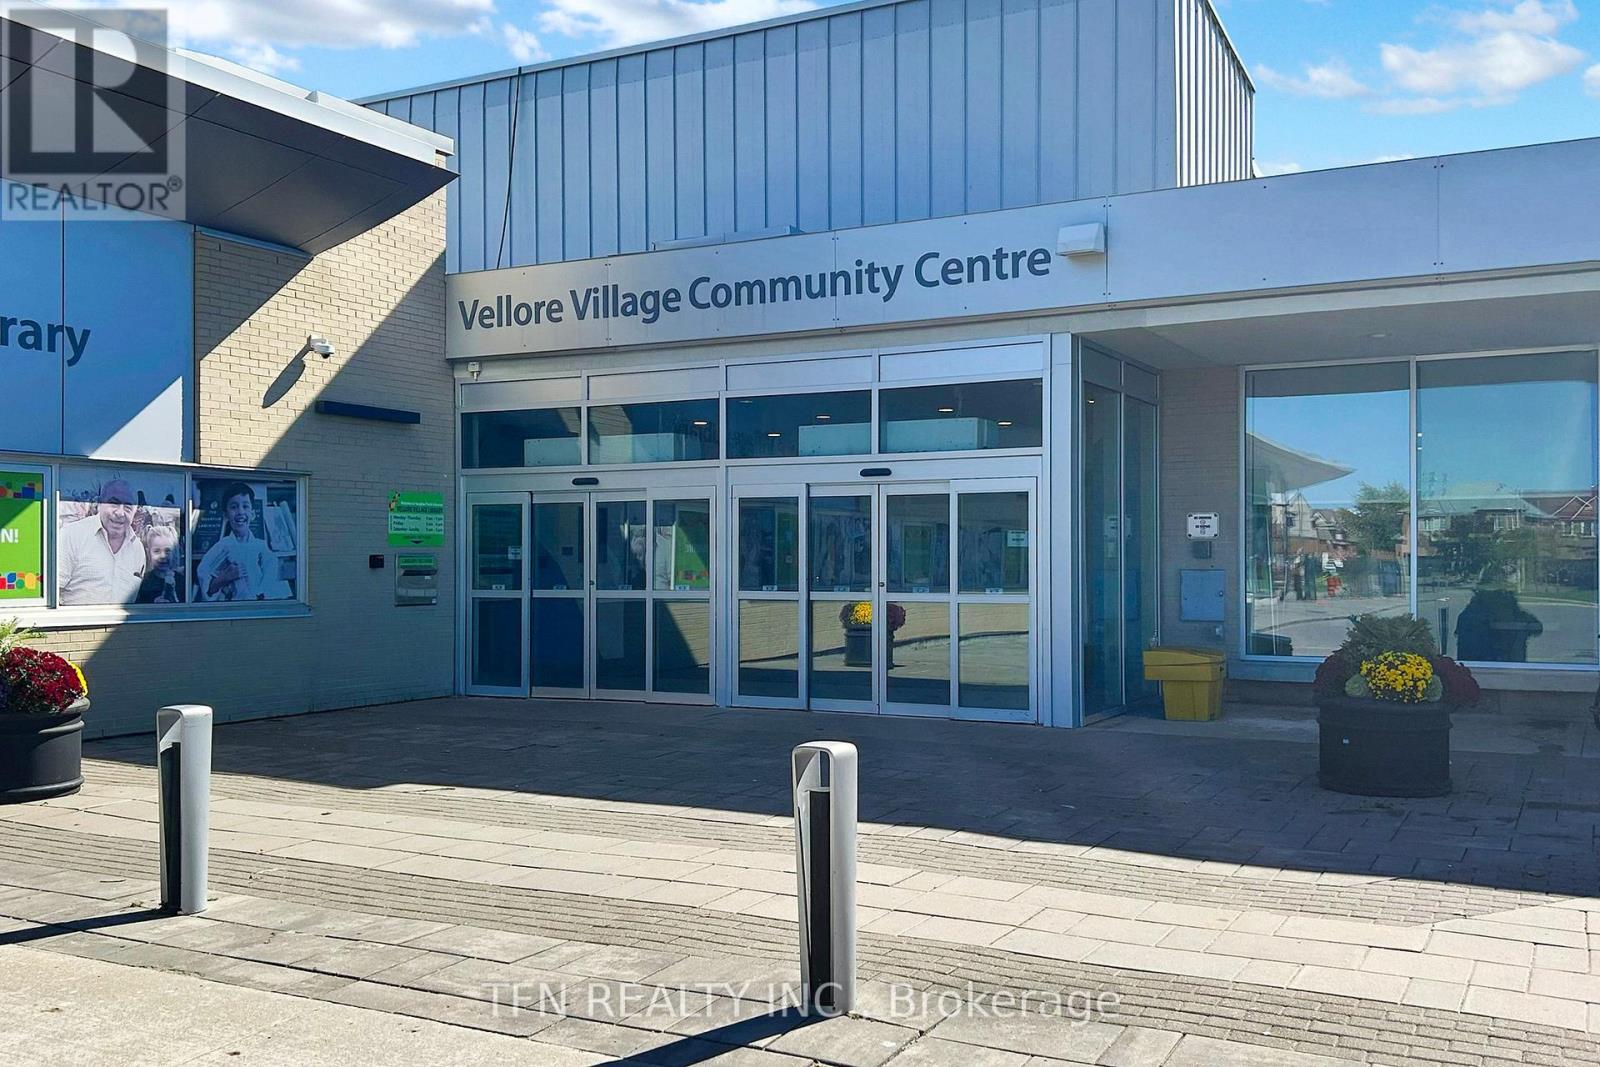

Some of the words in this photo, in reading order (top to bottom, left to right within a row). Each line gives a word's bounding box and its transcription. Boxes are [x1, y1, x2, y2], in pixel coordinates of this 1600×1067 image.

[458, 294, 564, 331] Vellore
[569, 284, 682, 324] Village
[688, 259, 904, 310] Community
[914, 247, 1051, 288] Centre
[0, 316, 91, 367] rary
